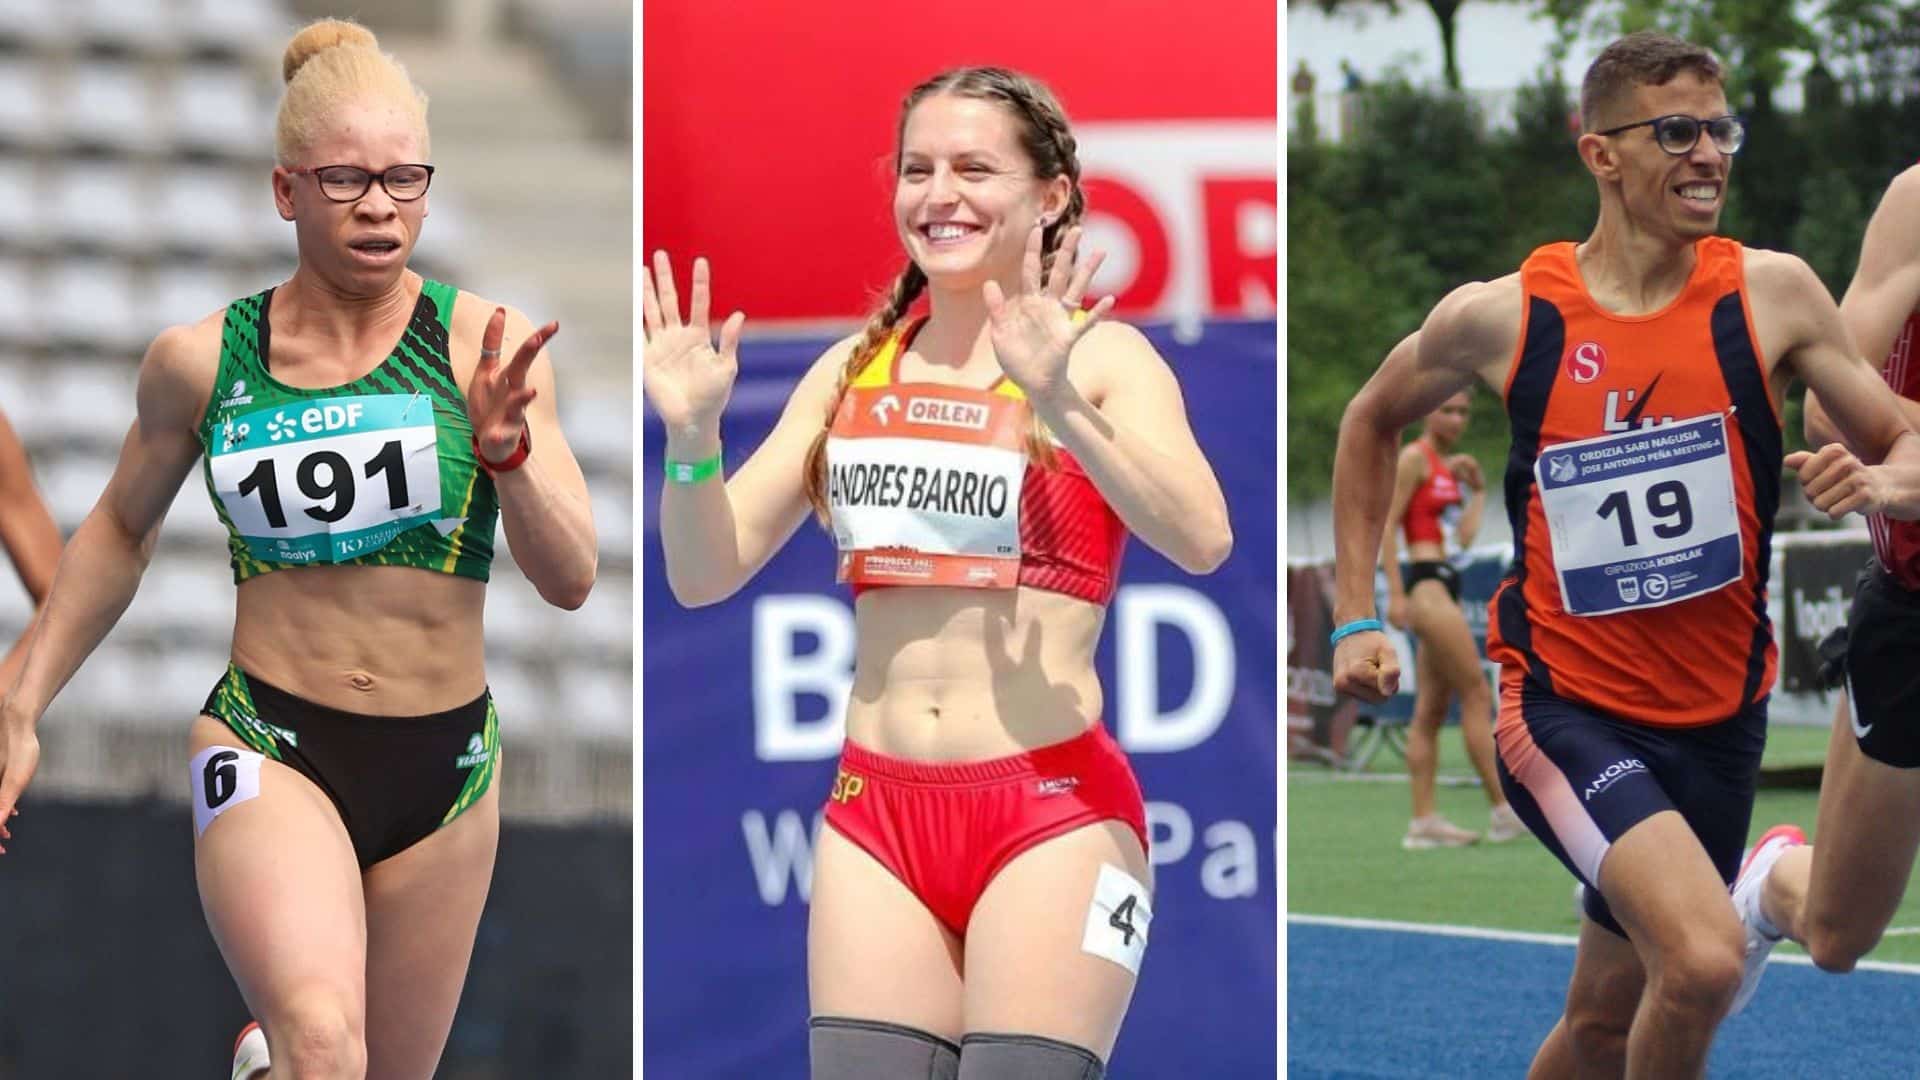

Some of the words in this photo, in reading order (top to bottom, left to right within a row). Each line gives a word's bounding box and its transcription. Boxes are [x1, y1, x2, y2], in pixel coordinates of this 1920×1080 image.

[1574, 342, 1600, 383] S
[301, 404, 363, 433] eDF
[911, 401, 982, 425] ORLEN
[1579, 447, 1623, 462] ORDIZIA
[1625, 441, 1650, 453] SARI
[1652, 430, 1701, 448] NAGUSIA
[1581, 463, 1603, 476] JOSE
[1604, 455, 1646, 471] ANTONIO
[238, 440, 409, 529] 191
[832, 463, 907, 507] ANDRES
[907, 467, 1008, 518] BARRIO
[1596, 480, 1693, 547] 19
[1657, 547, 1704, 567] KIROLAK
[203, 751, 239, 810] 6
[1108, 893, 1137, 946] 4
